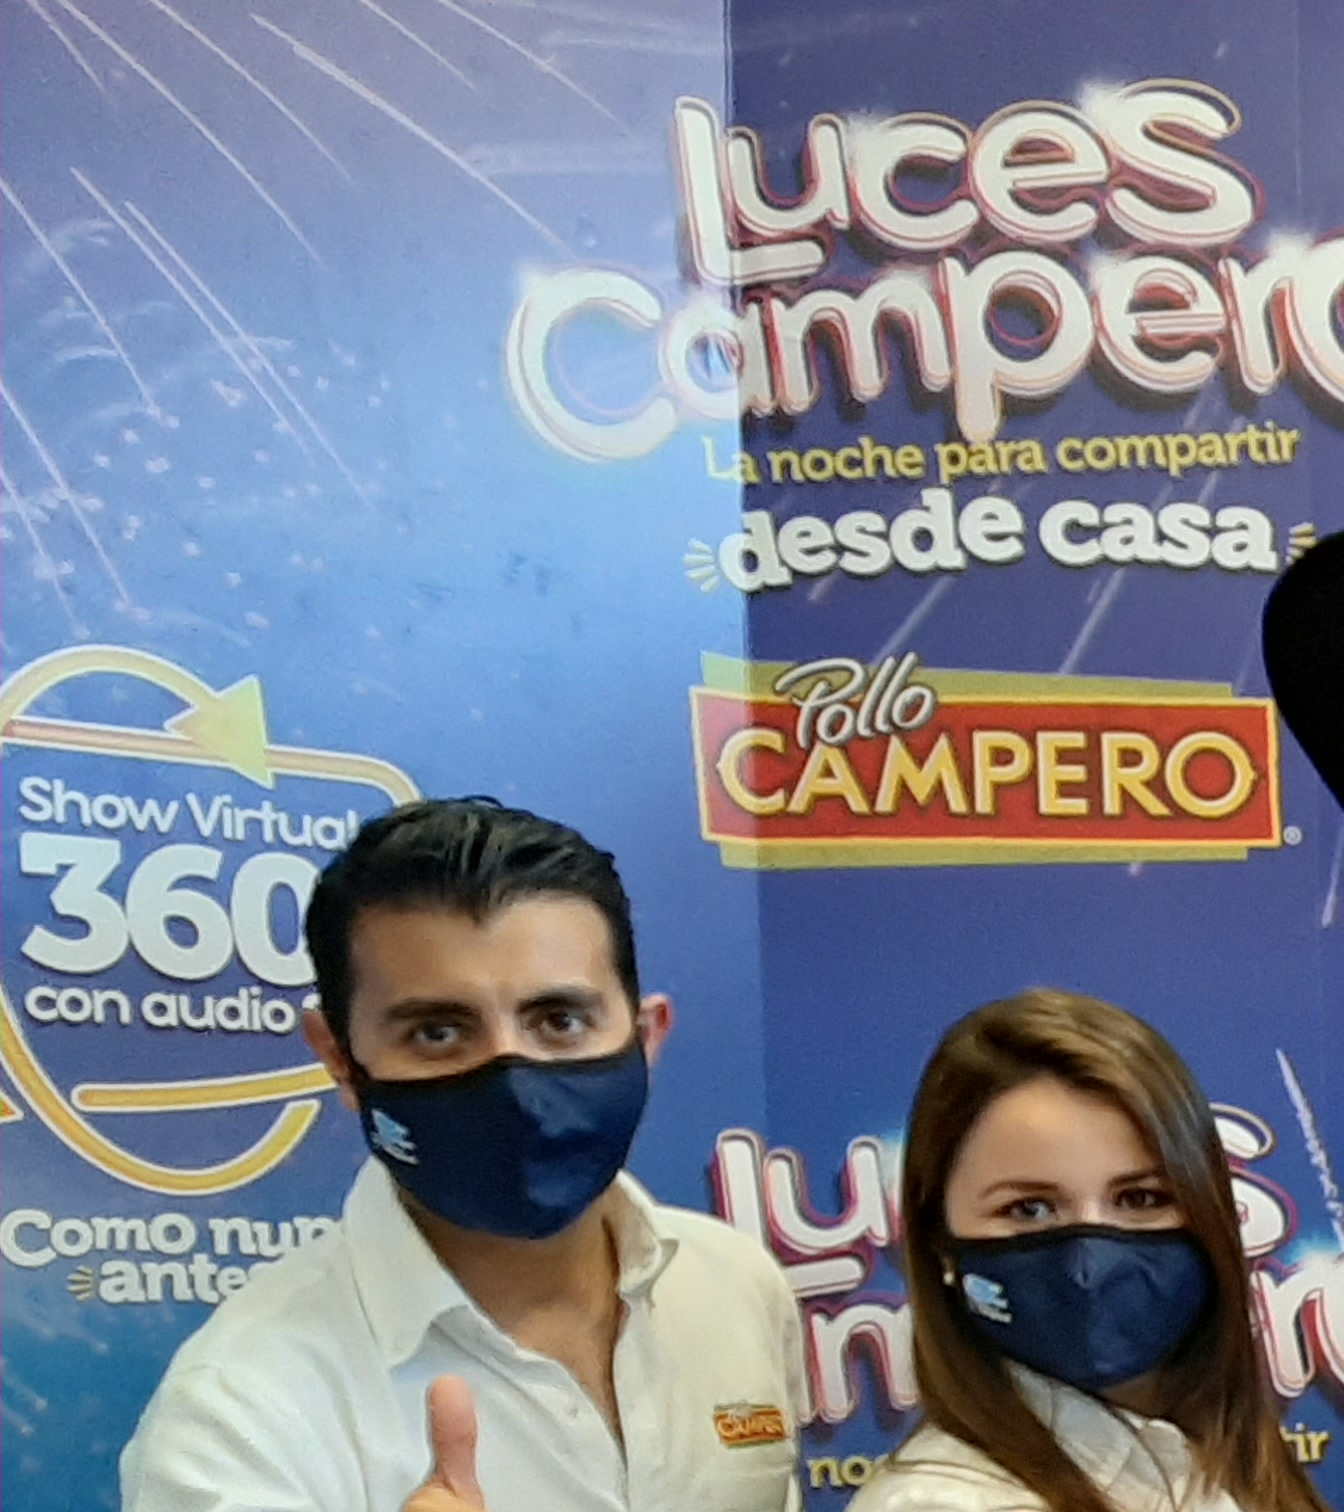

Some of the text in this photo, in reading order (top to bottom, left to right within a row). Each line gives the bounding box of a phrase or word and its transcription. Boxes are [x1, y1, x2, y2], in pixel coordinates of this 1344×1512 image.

[672, 77, 1262, 286] Luces
[702, 421, 1301, 485] La noche para compartir
[716, 489, 1280, 592] desde casa
[775, 651, 938, 750] Pollo
[19, 776, 360, 852] Show Virtual
[714, 731, 1260, 818] CAMPERO
[19, 831, 321, 987] 360
[25, 985, 131, 1027] con
[141, 987, 297, 1035] audio
[98, 1253, 250, 1305] ante
